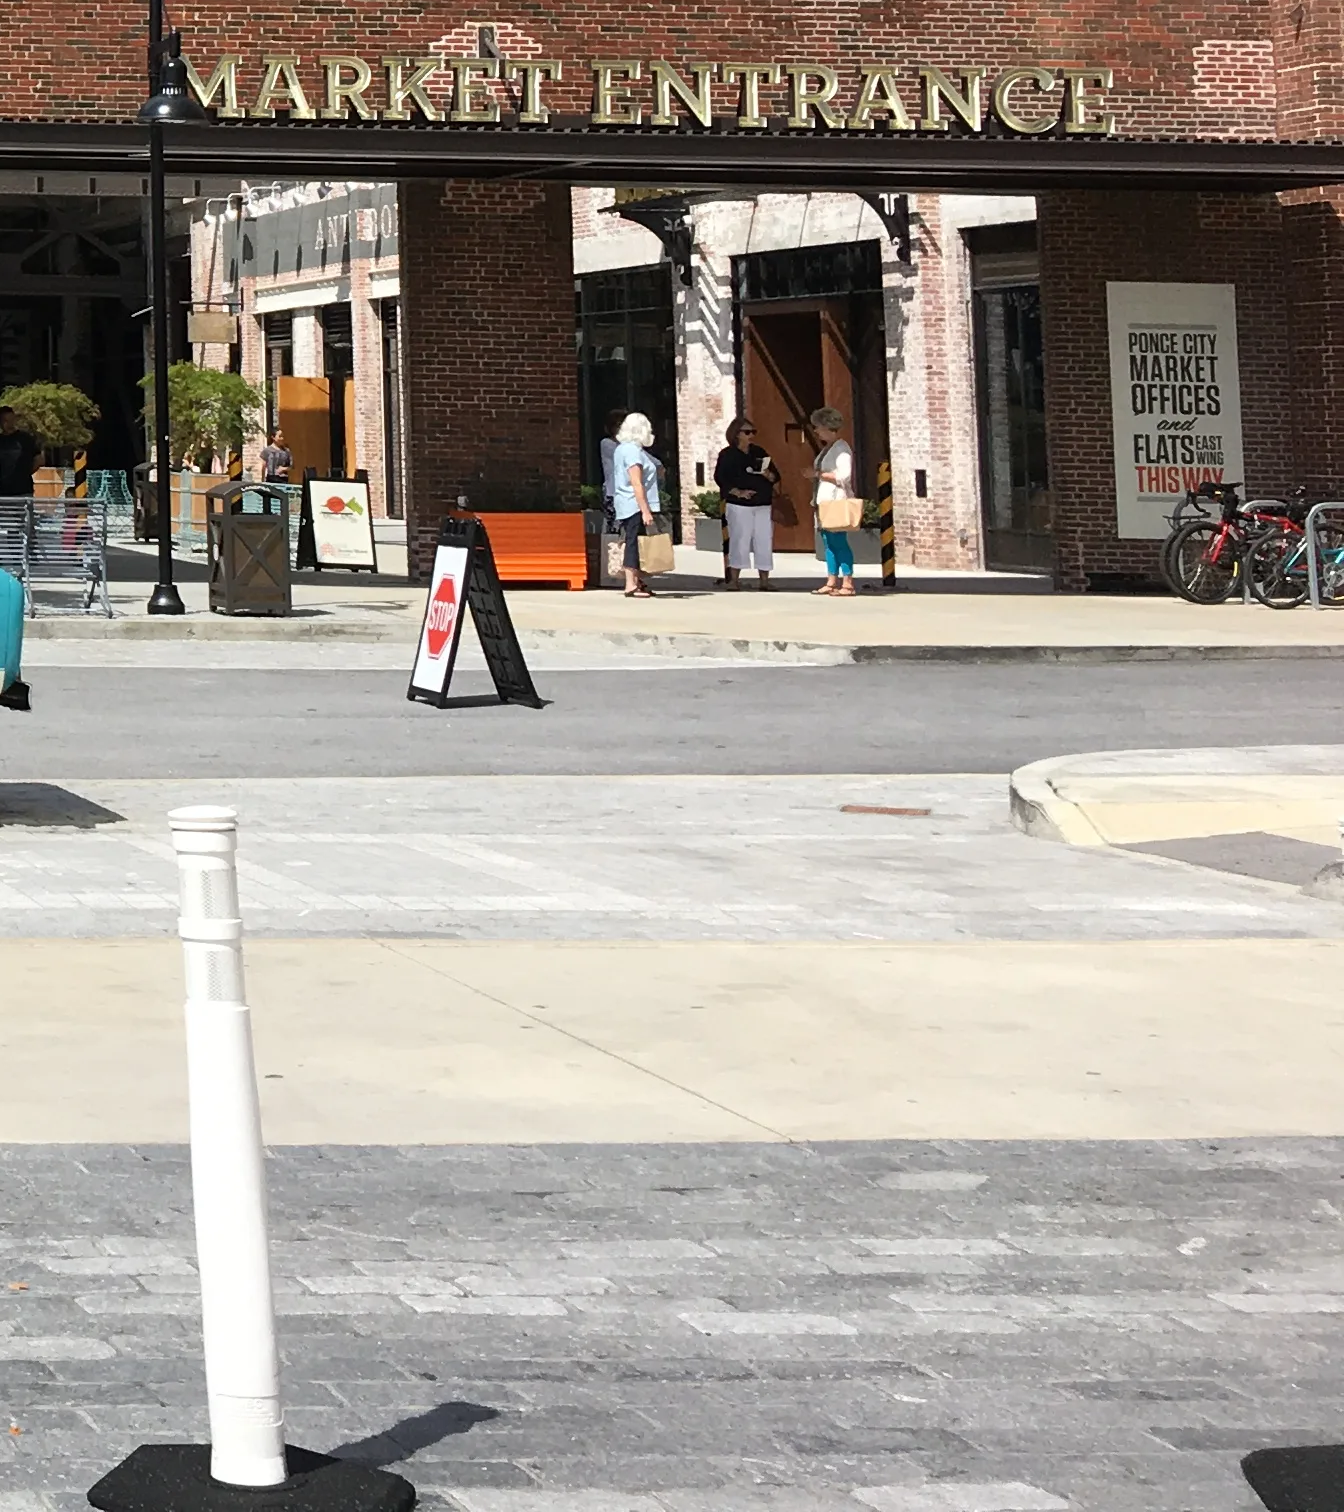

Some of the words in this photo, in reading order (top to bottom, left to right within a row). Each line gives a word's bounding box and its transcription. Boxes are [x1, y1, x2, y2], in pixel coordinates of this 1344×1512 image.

[179, 54, 563, 124] MARKET
[590, 58, 1117, 136] ENTRANCE
[1128, 332, 1179, 354] PONCE
[1183, 333, 1217, 355] CITY
[1129, 355, 1219, 383] MARKET
[1131, 383, 1221, 417] OFFICES
[1156, 417, 1199, 432] and
[1133, 434, 1195, 465] FLATS
[1196, 435, 1223, 451] EAST
[1196, 451, 1224, 466] WING
[1135, 466, 1180, 494] THIS
[428, 600, 455, 632] STOP
